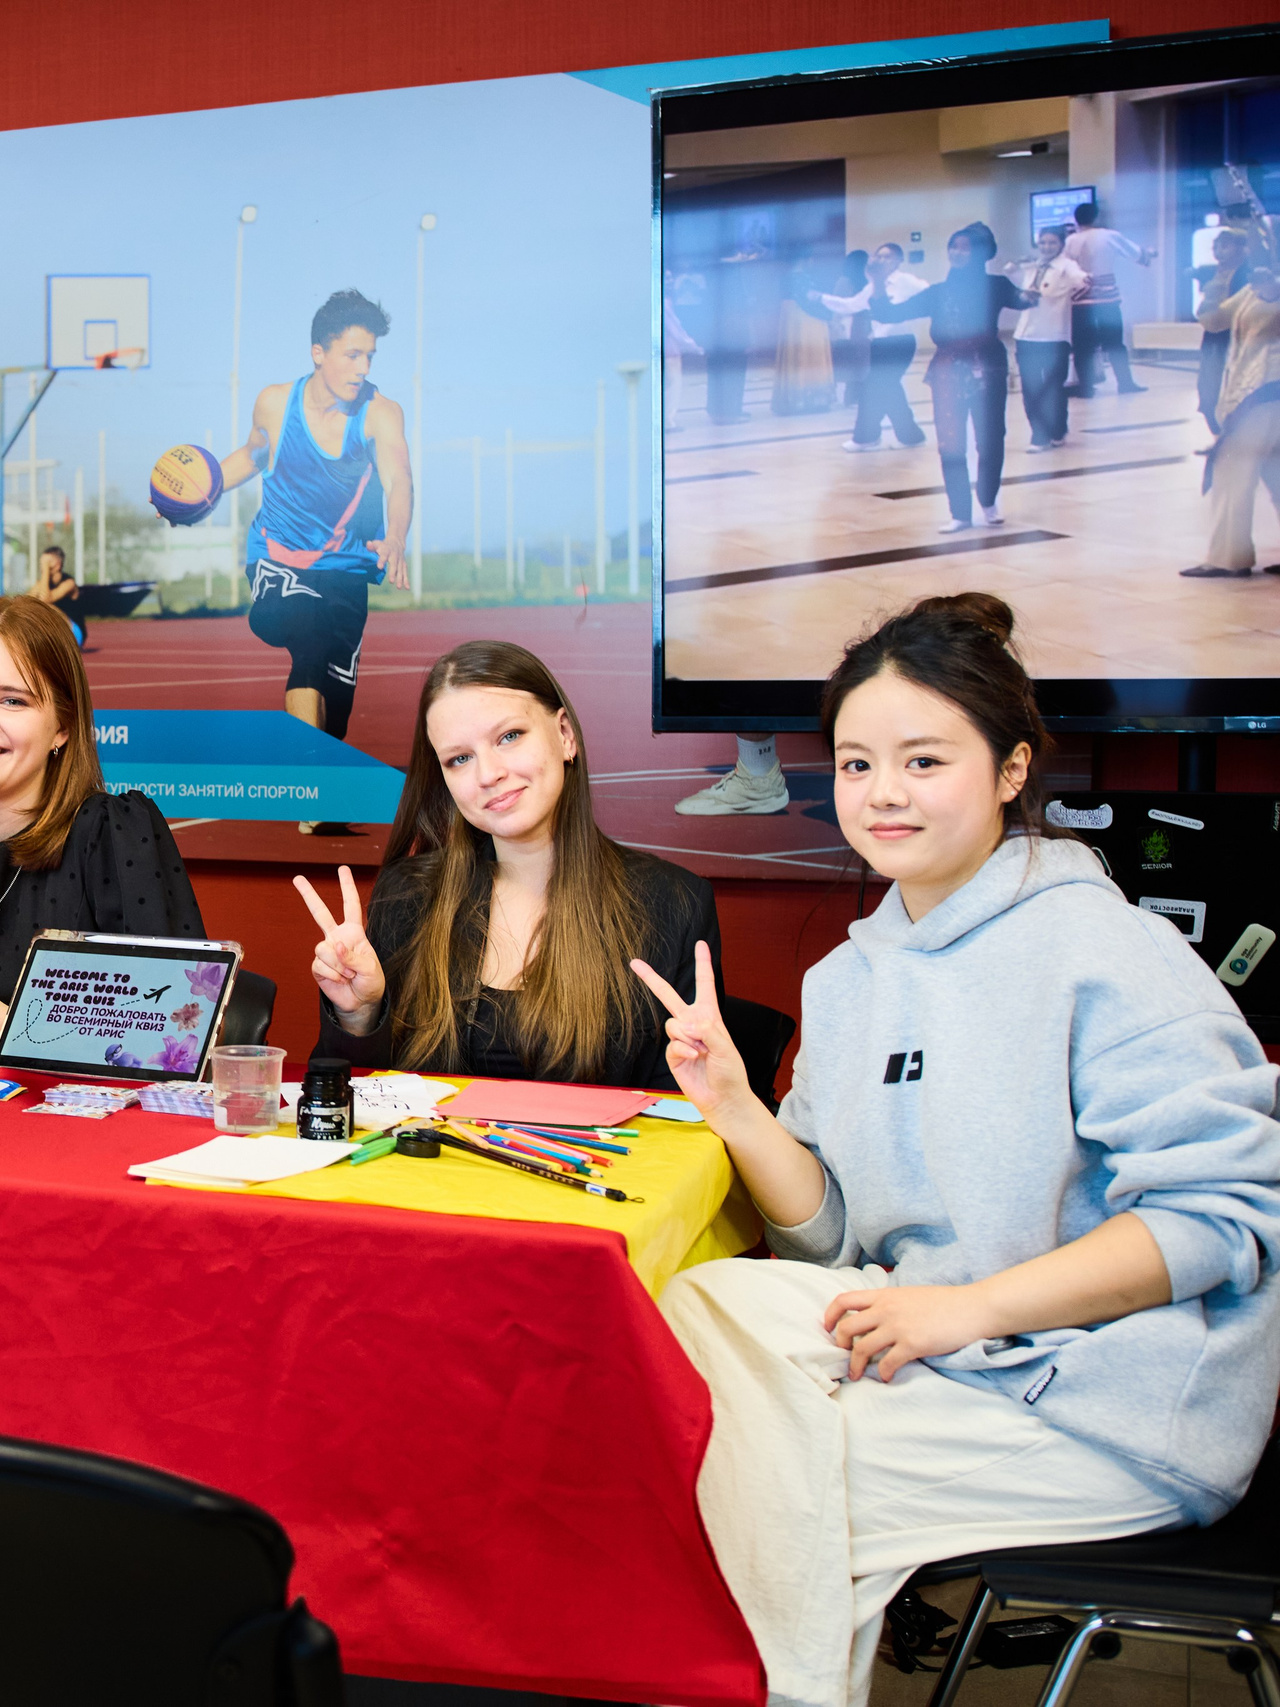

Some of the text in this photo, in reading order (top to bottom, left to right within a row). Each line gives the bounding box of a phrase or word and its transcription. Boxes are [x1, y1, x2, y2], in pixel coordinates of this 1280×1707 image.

[179, 782, 244, 798] ЗАНЯТИЙ
[248, 785, 319, 800] СПОРТОМ
[1150, 904, 1195, 914] ВЛАДИВОСТОК
[45, 968, 131, 983] WELCOME TO
[31, 979, 138, 996] THE ARIS WORLD
[45, 992, 116, 1006] TOUR QUIZ
[50, 1004, 167, 1022] ДОБРО ПОЖАЛОВАТЬ
[46, 1014, 165, 1032] ВО ВСЕМИРНЫЙ КВИЗ
[78, 1026, 125, 1039] ОТ АРИС
